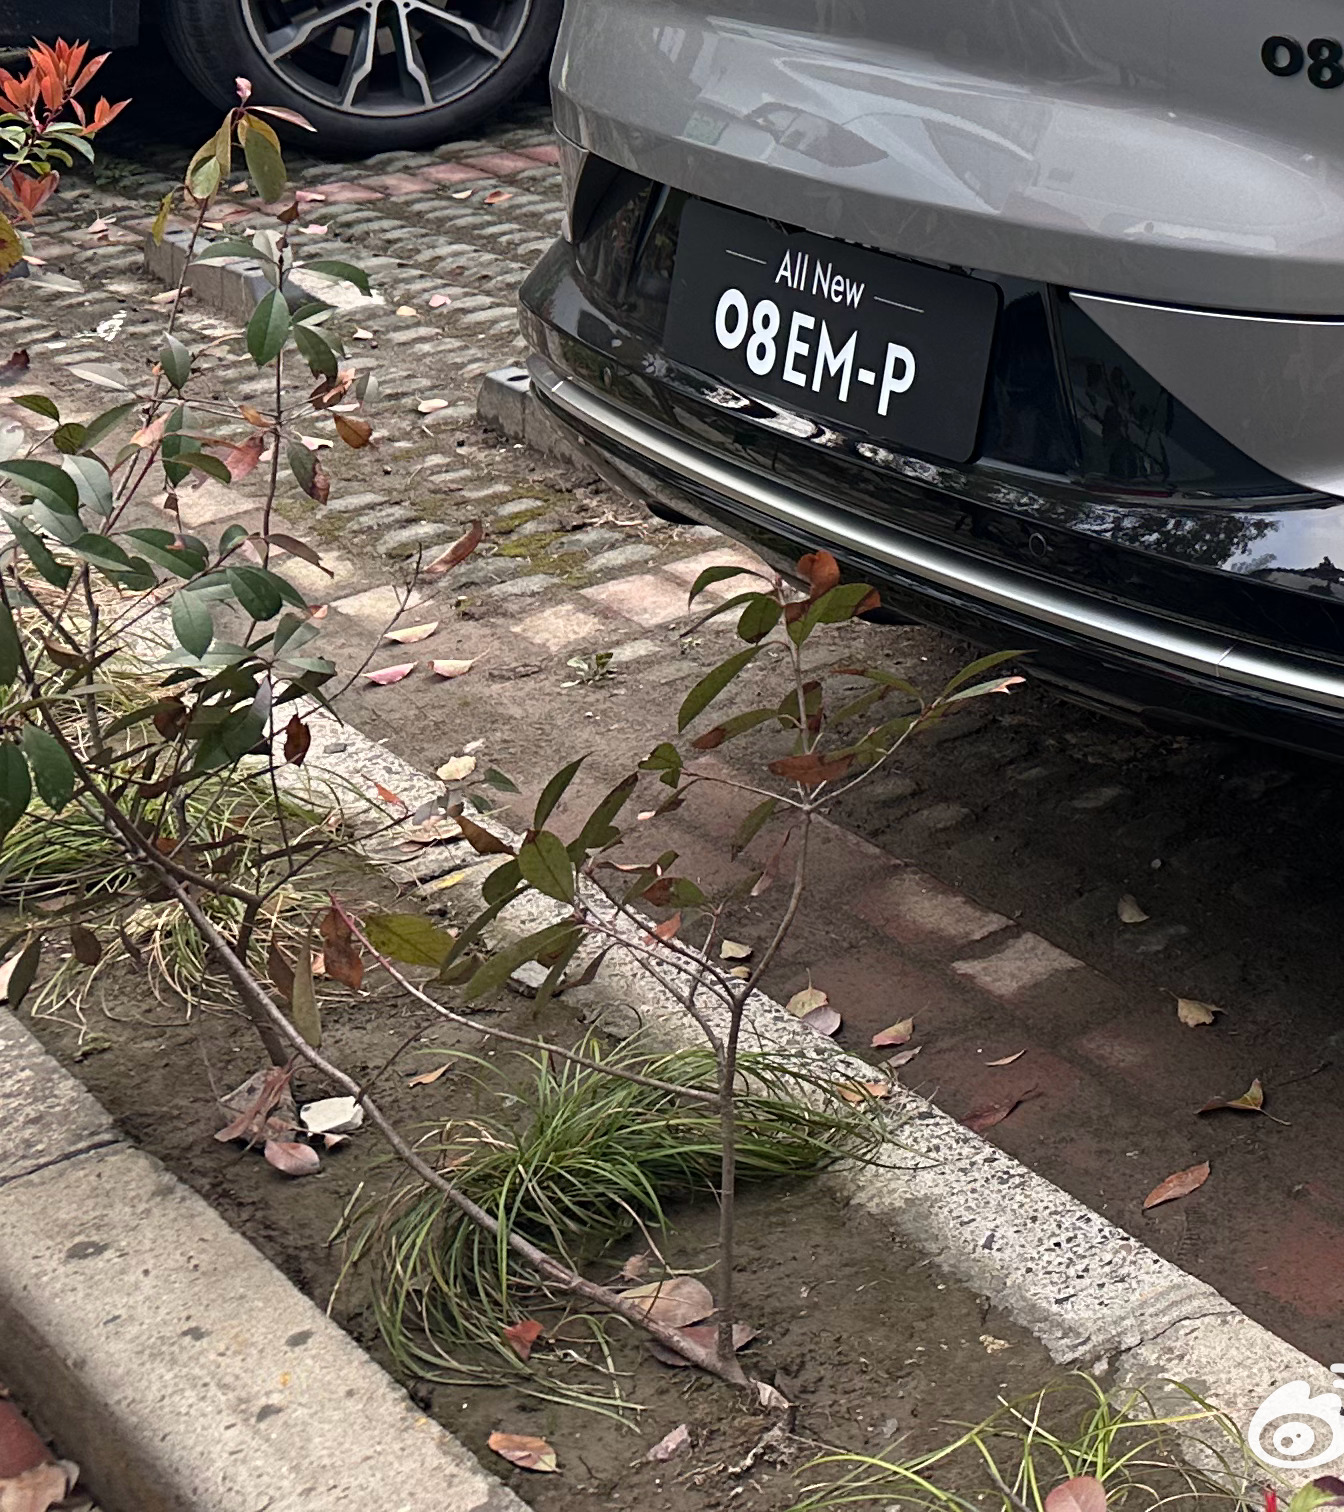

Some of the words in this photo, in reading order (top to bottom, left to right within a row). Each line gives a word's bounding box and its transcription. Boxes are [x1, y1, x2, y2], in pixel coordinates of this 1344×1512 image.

[1261, 36, 1344, 89] 08
[775, 249, 809, 291] All
[812, 259, 866, 310] New
